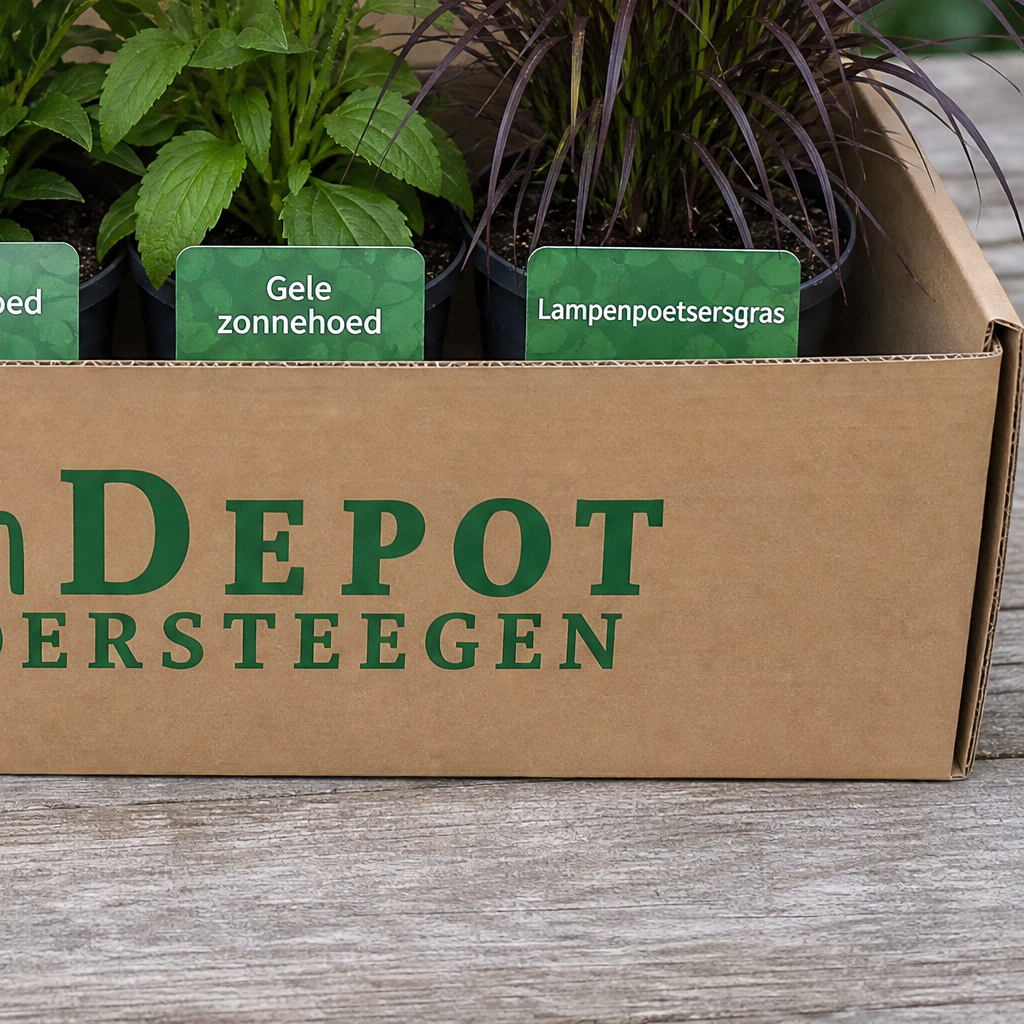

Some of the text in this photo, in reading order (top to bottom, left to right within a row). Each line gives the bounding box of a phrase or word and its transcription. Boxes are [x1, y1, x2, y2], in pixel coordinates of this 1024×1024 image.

[266, 274, 332, 302] Gele
[216, 307, 382, 336] zonnehoed
[537, 297, 786, 330] Lampenpoetsersgras
